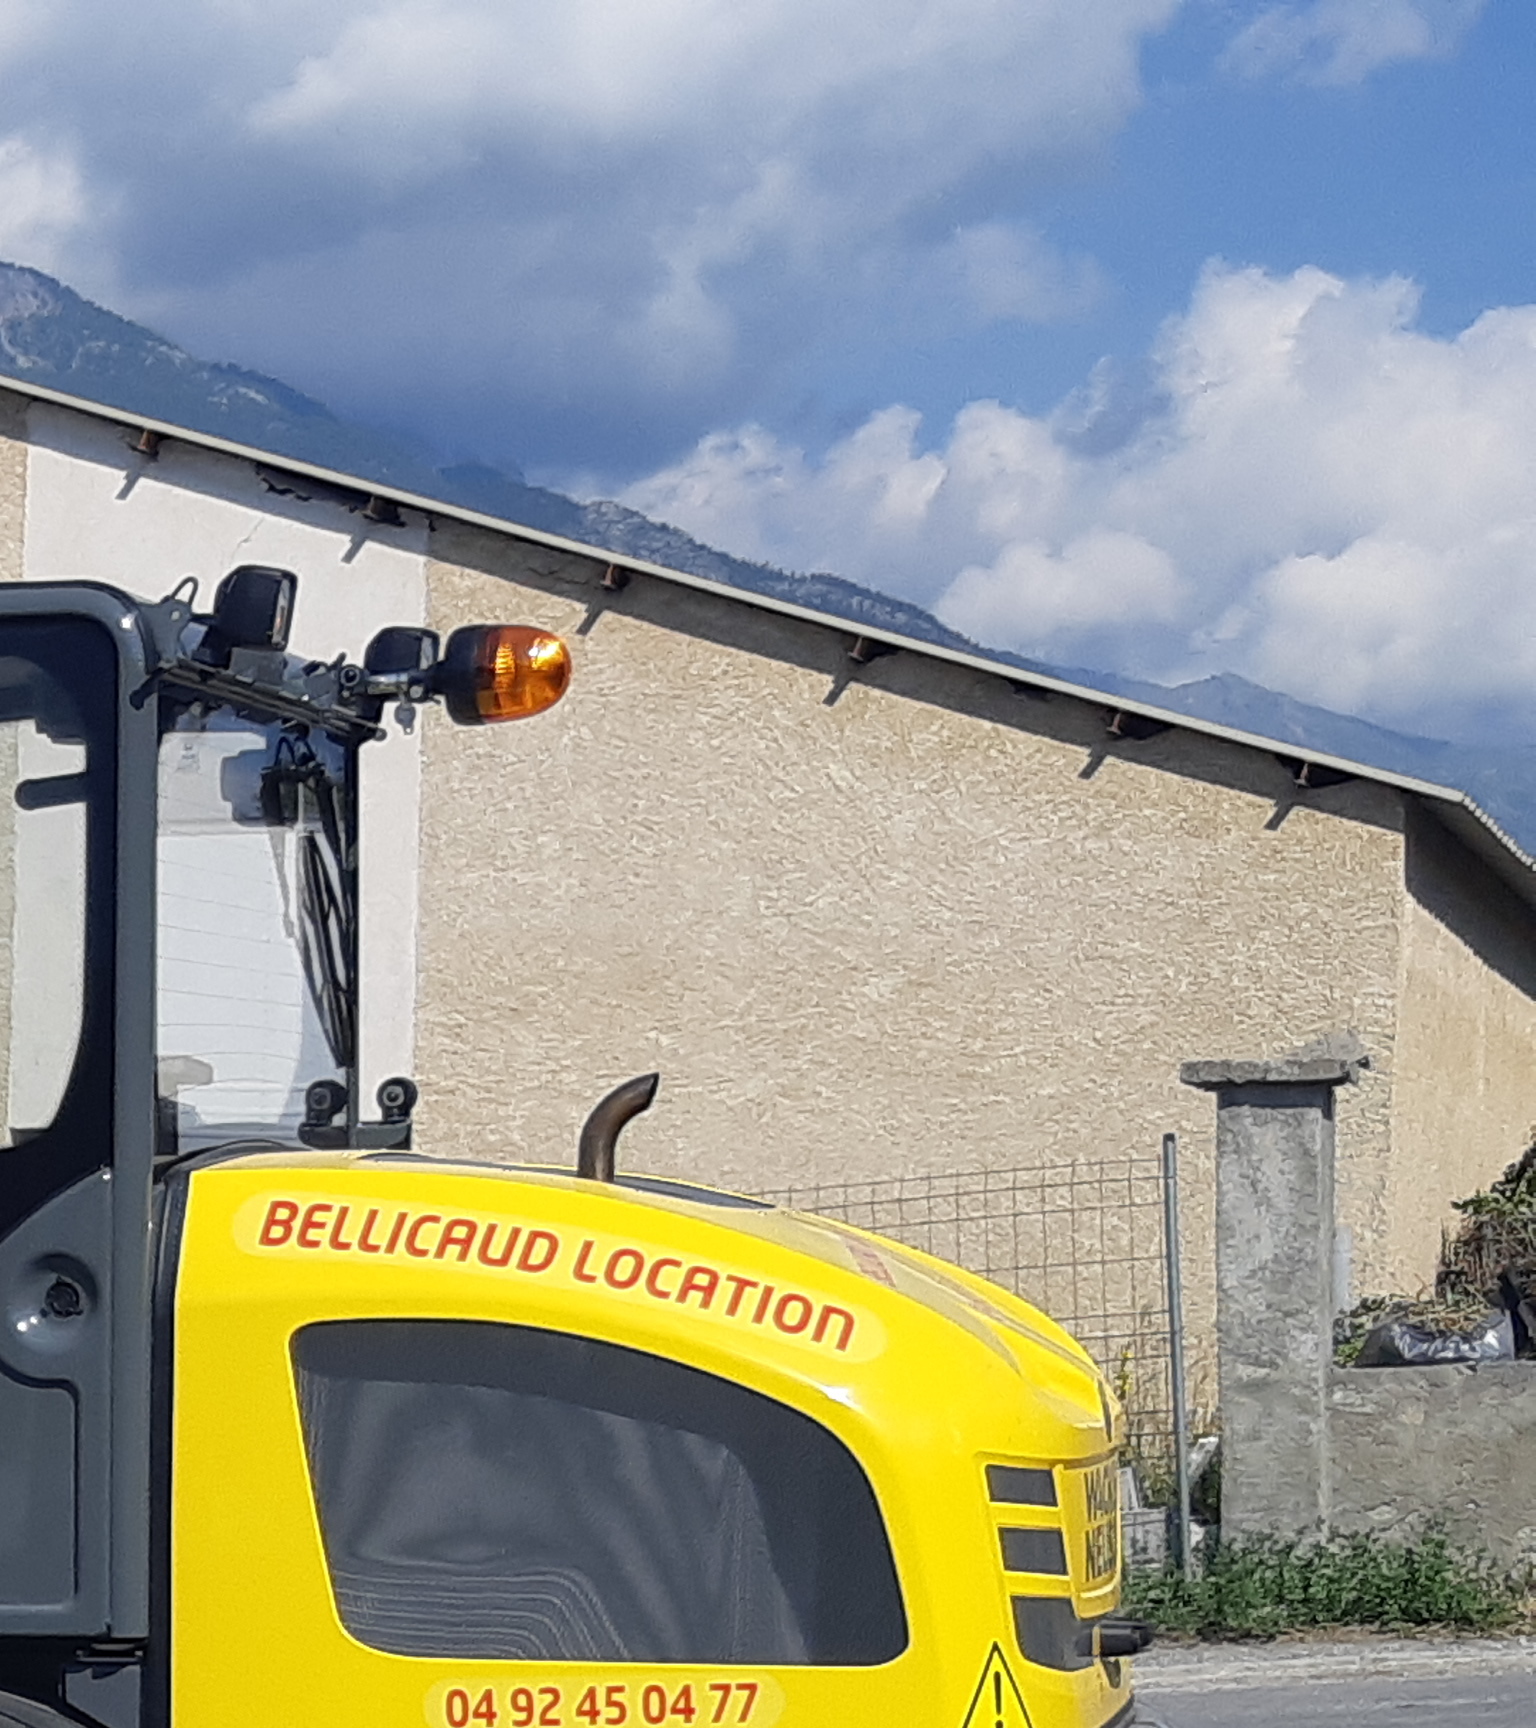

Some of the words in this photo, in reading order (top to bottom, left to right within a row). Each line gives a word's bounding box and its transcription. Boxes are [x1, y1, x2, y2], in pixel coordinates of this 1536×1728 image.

[258, 1200, 560, 1273] BELLICAUD
[572, 1239, 855, 1352] LOCATION
[445, 1688, 497, 1728] 04
[510, 1687, 561, 1727] 92
[575, 1685, 627, 1726] 45
[642, 1684, 696, 1725] 04
[708, 1682, 759, 1723] 77
